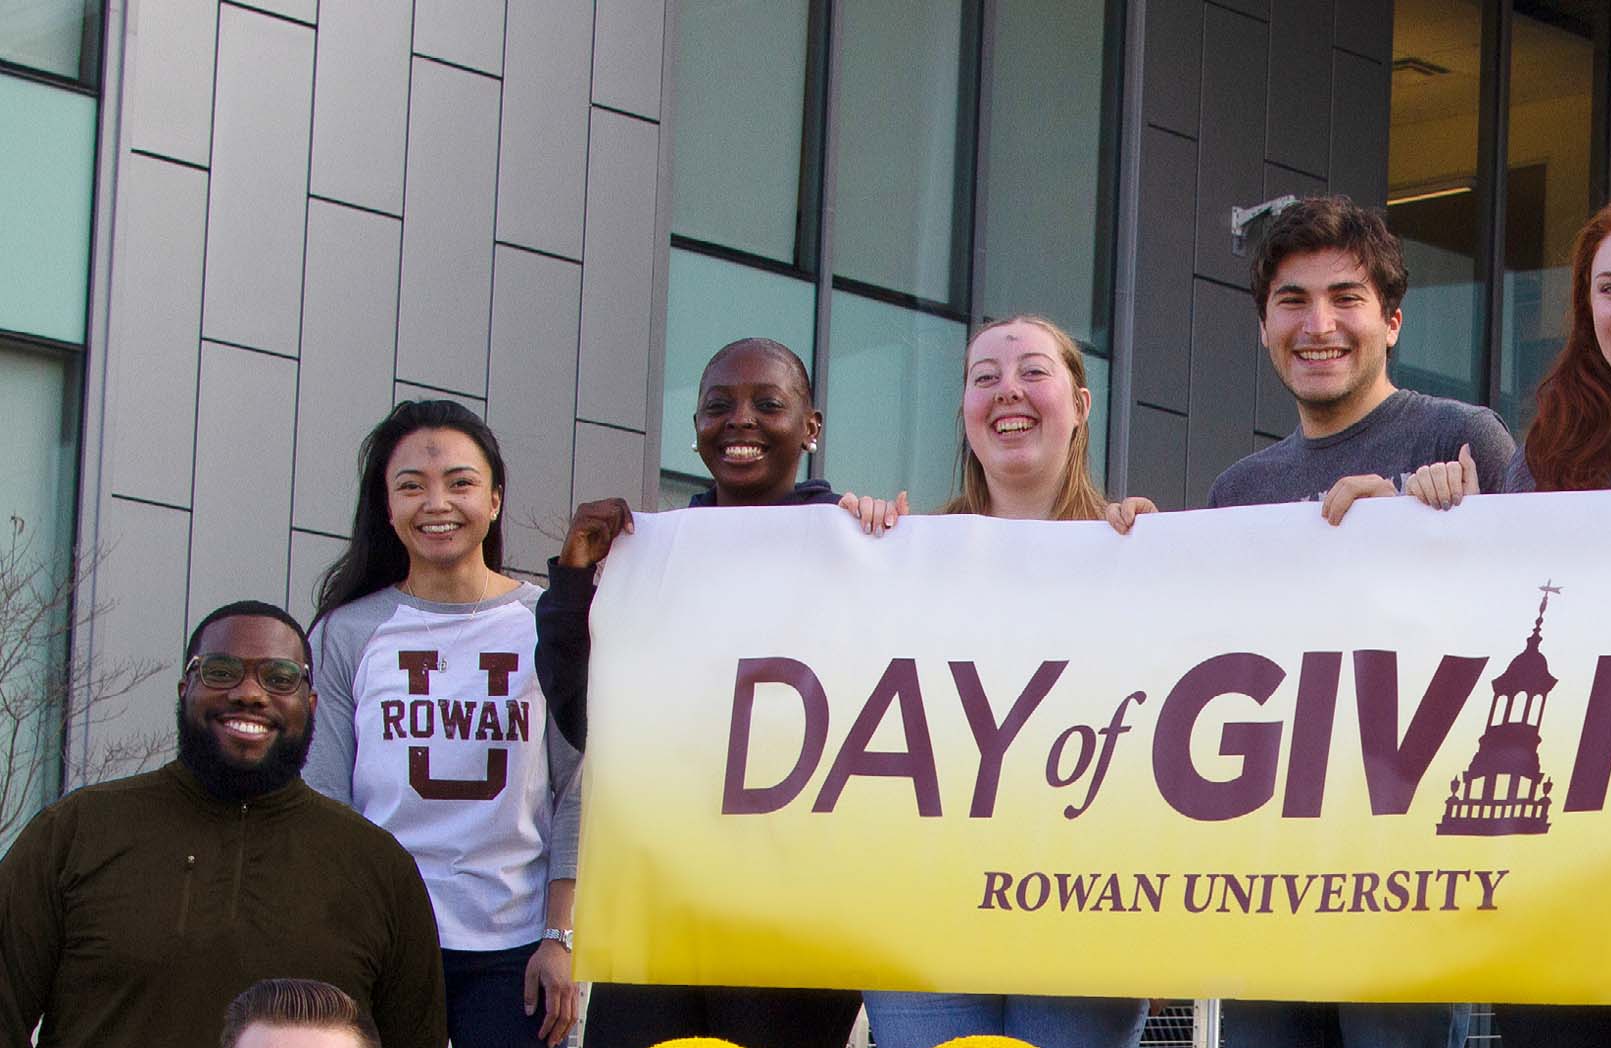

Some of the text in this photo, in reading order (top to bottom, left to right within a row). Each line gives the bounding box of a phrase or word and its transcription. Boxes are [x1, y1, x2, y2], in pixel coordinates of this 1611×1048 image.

[381, 699, 529, 742] ROWAN
[722, 656, 1069, 818] DAY
[1046, 689, 1147, 820] of
[978, 868, 1511, 914] ROWAN UNIVERSITY
